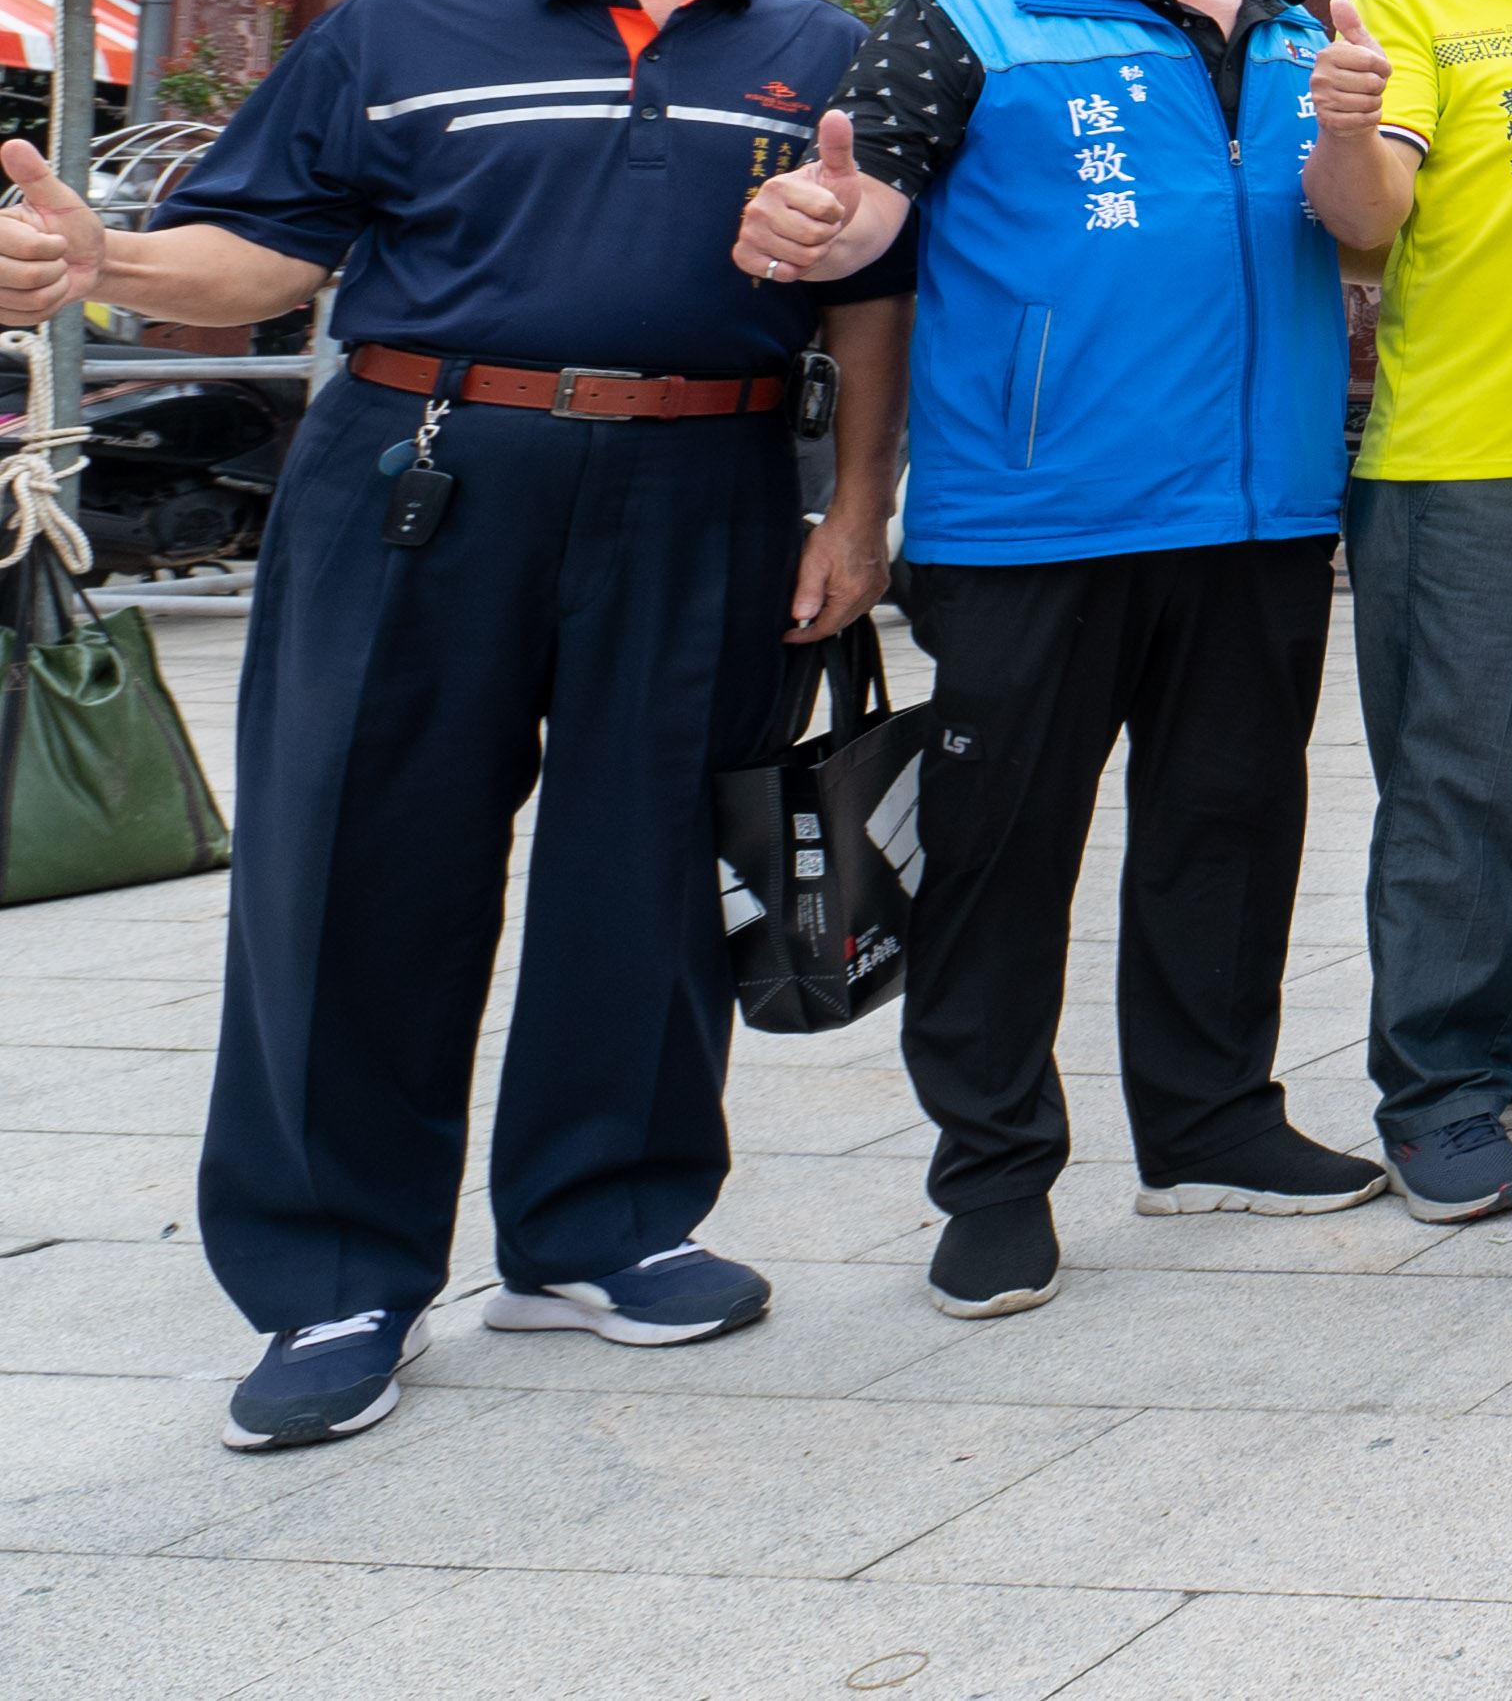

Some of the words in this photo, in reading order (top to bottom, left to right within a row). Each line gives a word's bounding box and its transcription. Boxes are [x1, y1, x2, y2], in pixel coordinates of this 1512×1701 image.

[1119, 65, 1148, 103] 秘書
[751, 137, 770, 177] 理事長
[1067, 93, 1141, 231] 陸敬灝
